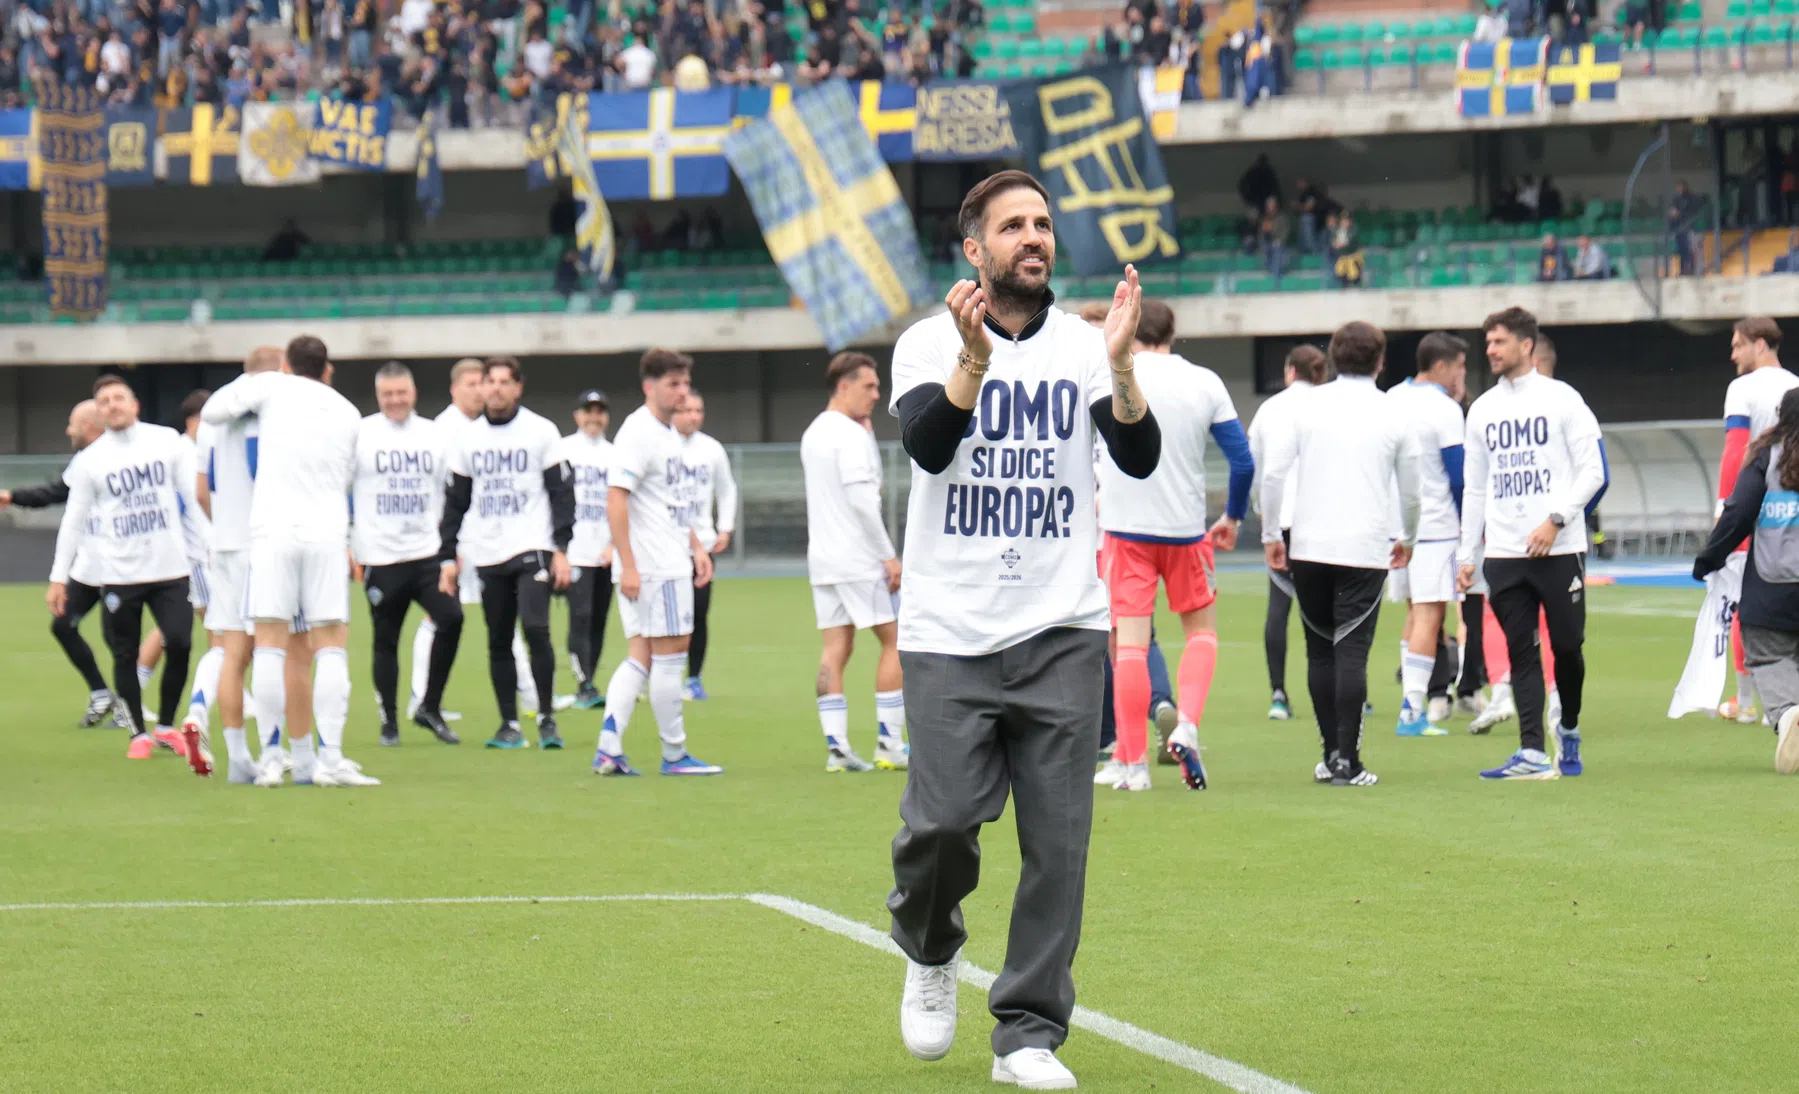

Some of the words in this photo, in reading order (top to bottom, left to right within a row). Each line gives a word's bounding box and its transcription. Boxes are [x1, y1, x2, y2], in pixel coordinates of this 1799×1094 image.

[1485, 415, 1548, 453] COMO
[376, 449, 433, 474] COMO
[471, 448, 528, 477] COMO
[971, 446, 995, 479] SI
[1001, 448, 1056, 480] DICE
[1497, 454, 1508, 469] SI
[1510, 450, 1537, 468] DICE
[105, 460, 165, 497] COMO
[944, 483, 1075, 539] EUROPA?
